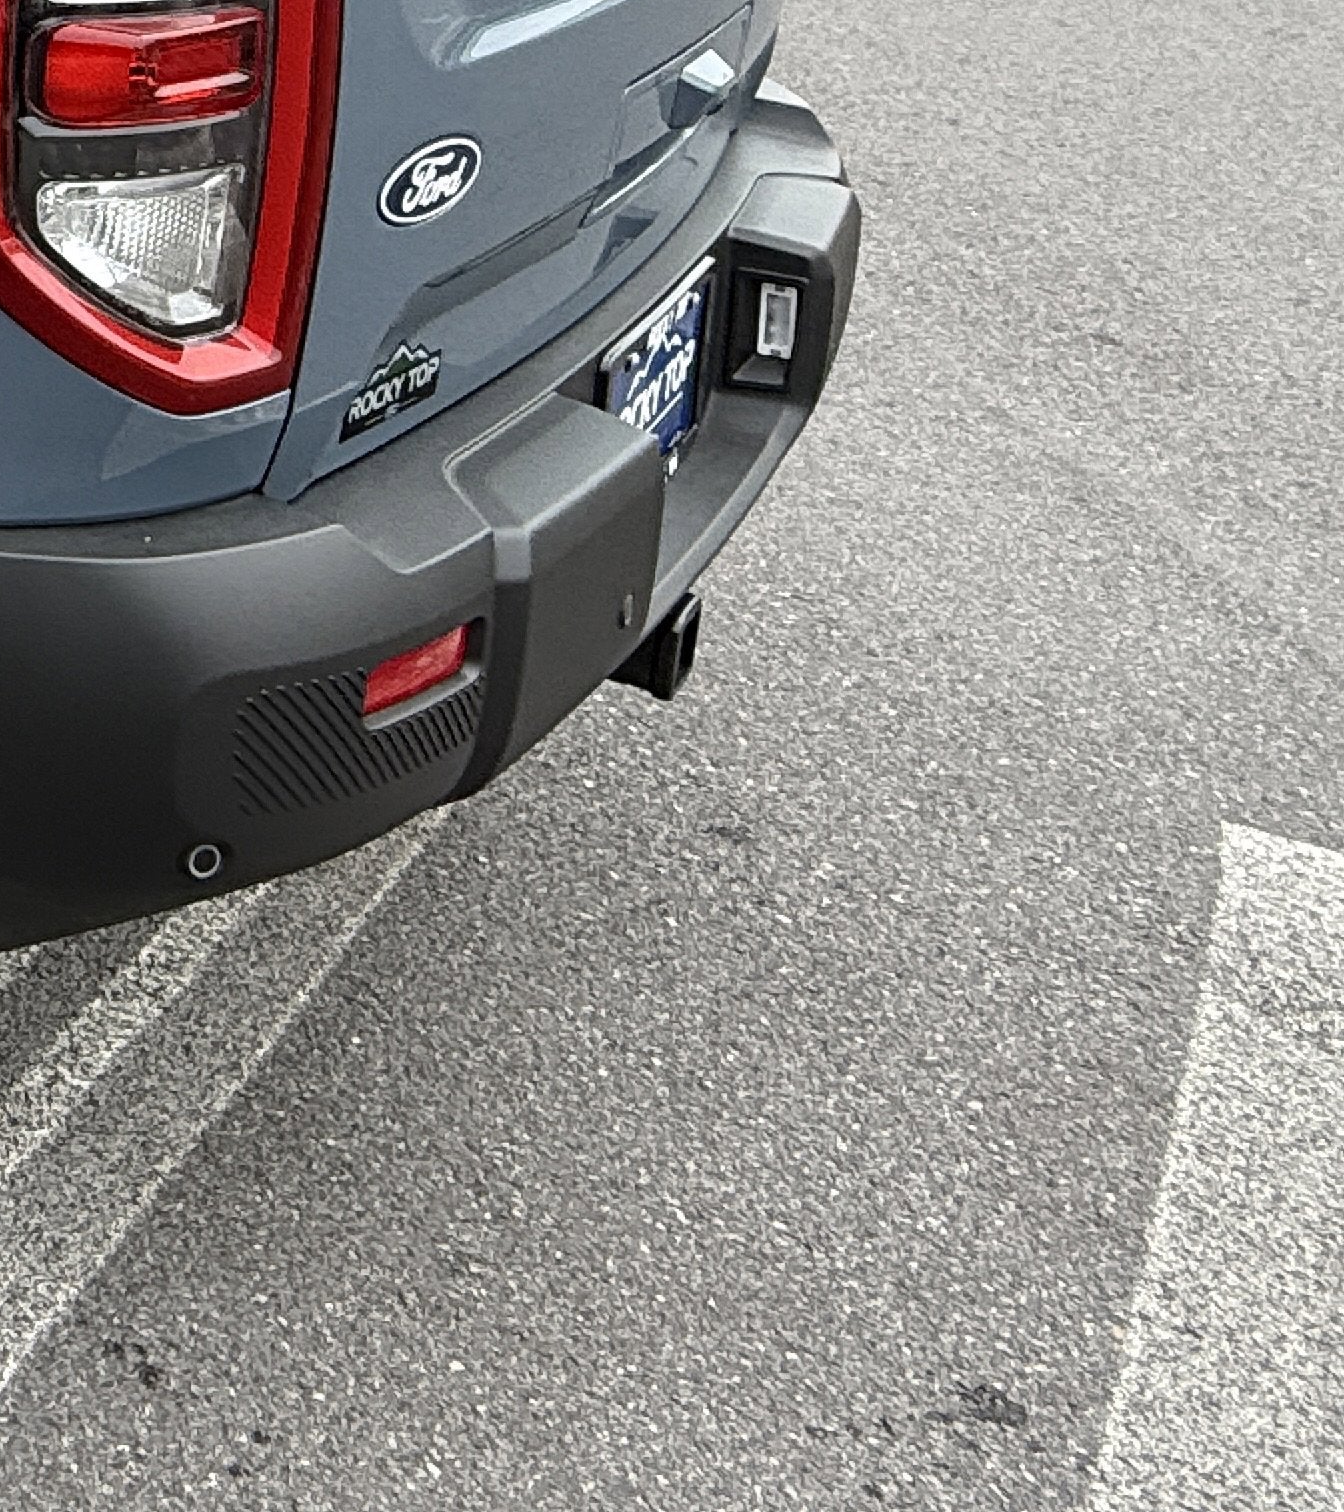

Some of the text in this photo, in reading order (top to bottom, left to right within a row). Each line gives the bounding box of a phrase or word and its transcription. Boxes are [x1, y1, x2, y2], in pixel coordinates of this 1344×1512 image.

[401, 152, 468, 213] Ford
[348, 356, 440, 424] ROCKY TOP
[664, 338, 696, 402] TOP
